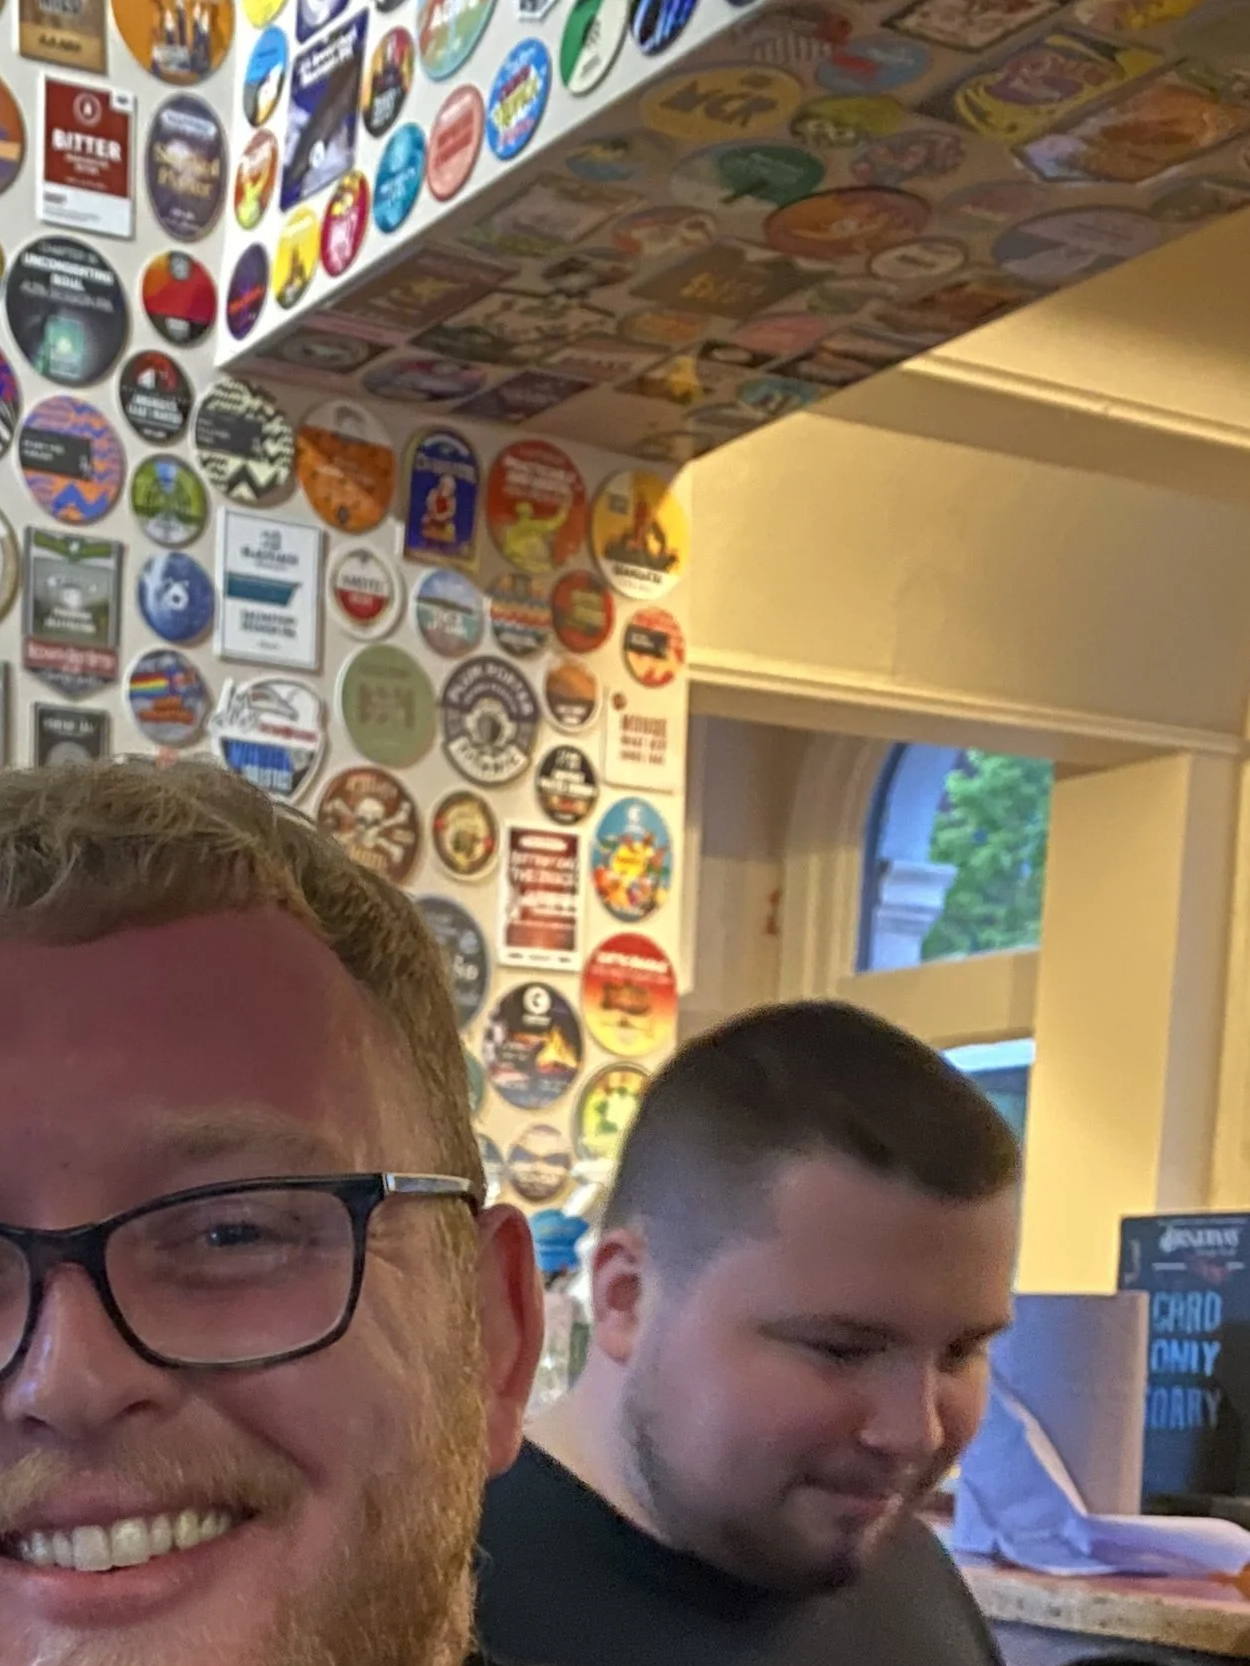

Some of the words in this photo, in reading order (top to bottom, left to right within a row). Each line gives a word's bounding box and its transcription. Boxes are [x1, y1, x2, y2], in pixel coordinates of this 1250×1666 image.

[52, 127, 122, 162] BITTER
[1151, 1290, 1223, 1334] CARD
[1150, 1338, 1221, 1378] ONLY
